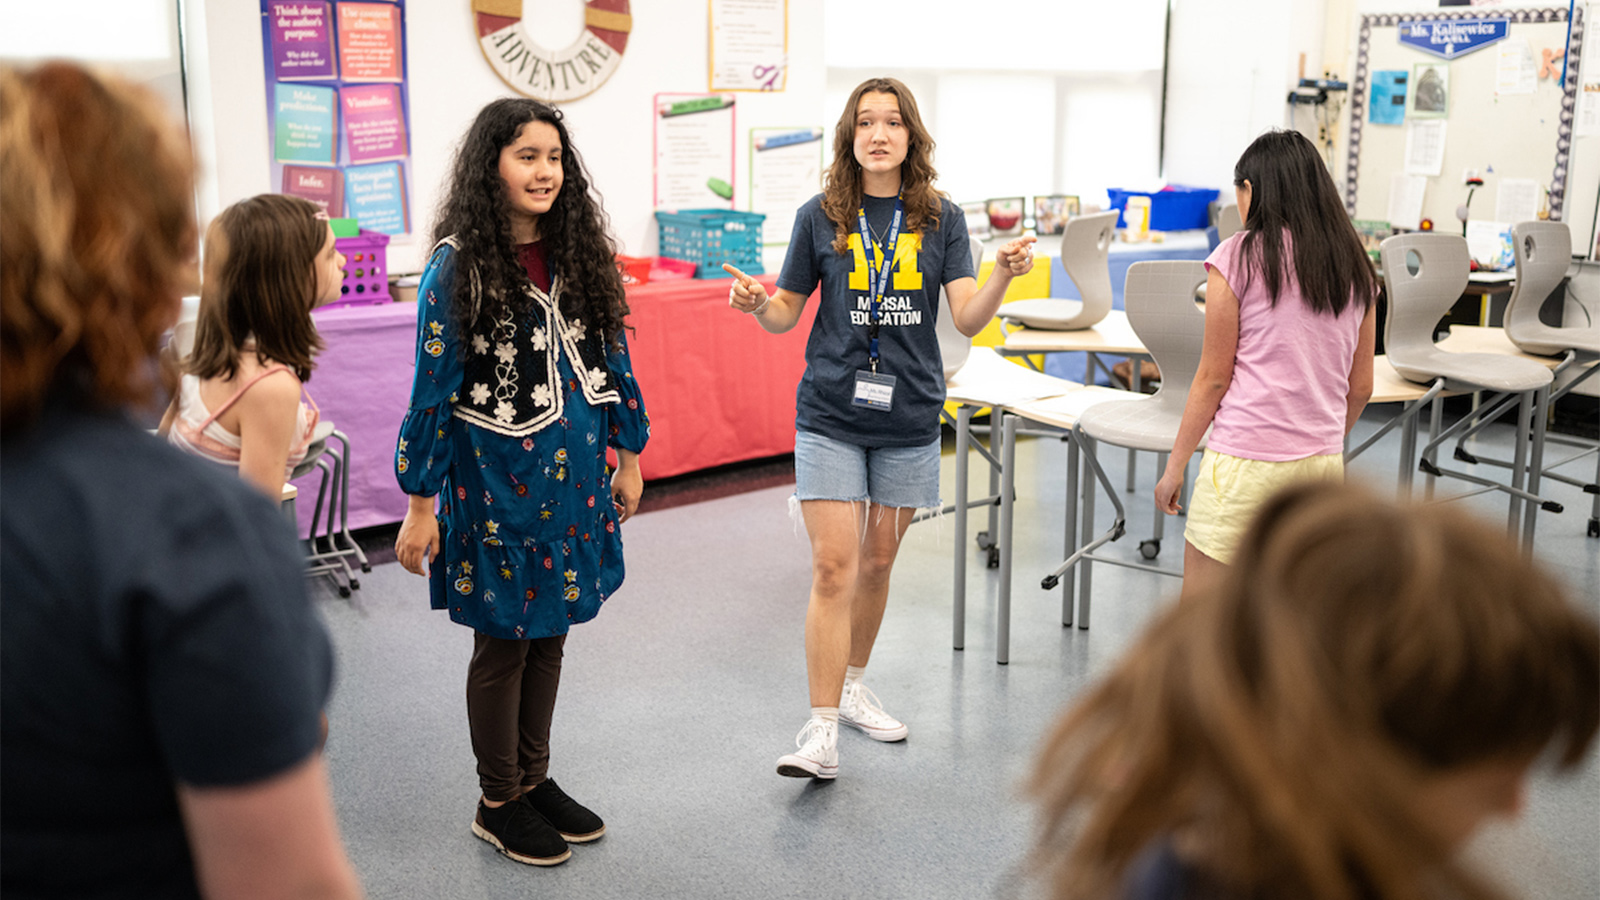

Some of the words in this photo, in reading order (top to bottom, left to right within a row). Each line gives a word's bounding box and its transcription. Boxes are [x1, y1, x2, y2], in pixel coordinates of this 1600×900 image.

[274, 5, 299, 16] Think
[301, 5, 323, 15] about
[342, 7, 358, 18] Use
[359, 9, 390, 18] context
[277, 17, 291, 27] the
[292, 17, 323, 27] author's
[354, 20, 379, 29] clues.
[284, 30, 318, 41] purpose.
[1411, 24, 1429, 37] Ms.
[286, 51, 300, 60] Why
[491, 32, 611, 90] ADVENTURE
[293, 90, 316, 102] Make
[279, 101, 328, 113] predictions.
[349, 168, 395, 183] Distinguish
[299, 175, 324, 189] Infer.
[353, 183, 371, 193] facts
[373, 182, 393, 191] from
[356, 193, 393, 206] opinions.
[847, 232, 923, 290] M
[857, 296, 913, 311] MRSAL
